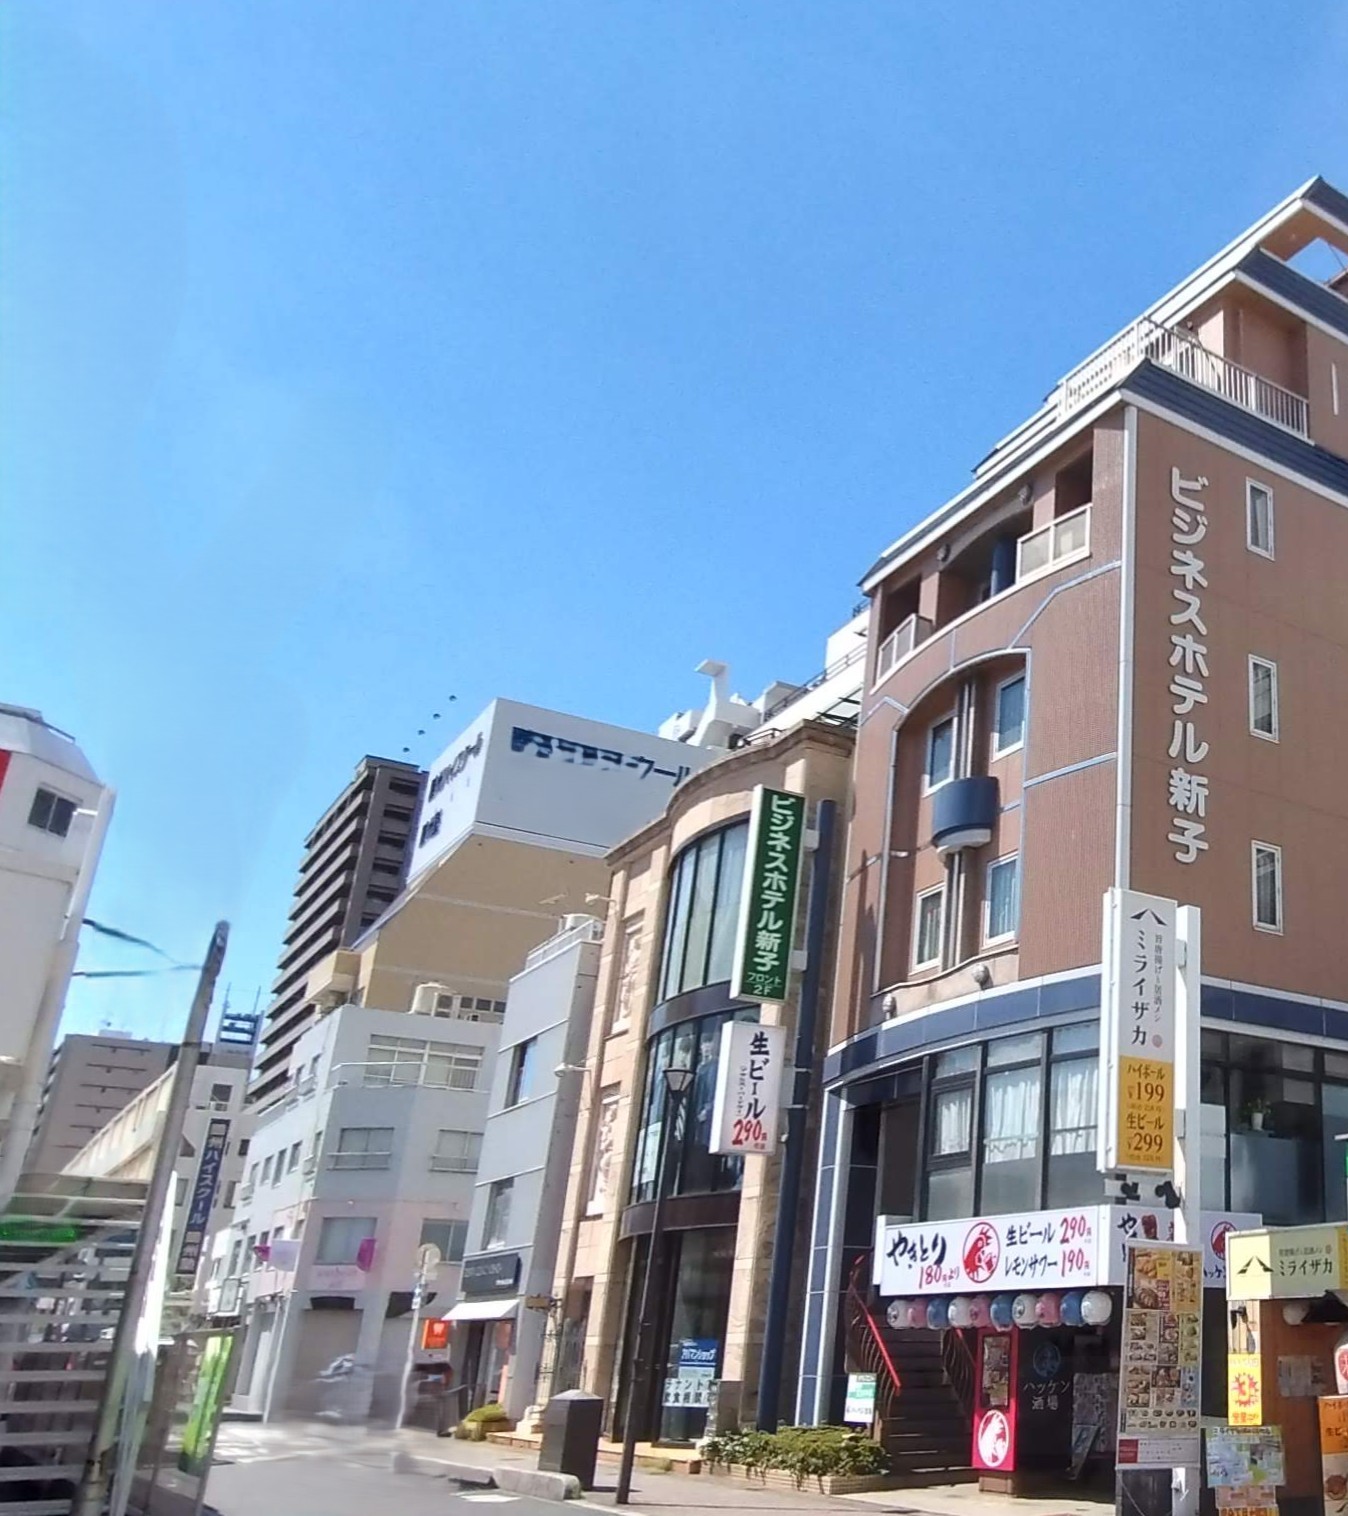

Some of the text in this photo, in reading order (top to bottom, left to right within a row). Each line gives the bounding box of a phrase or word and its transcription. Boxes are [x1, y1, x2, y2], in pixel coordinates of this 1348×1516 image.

[1168, 466, 1209, 864] ビジネスホテル新子
[751, 794, 795, 972] ビジネスホテル新子
[745, 971, 782, 988] フロント
[753, 984, 773, 996] 2F
[1131, 930, 1150, 1045] ミライザカ
[744, 1031, 770, 1119] 生ビール
[1128, 1064, 1165, 1080] ハイボール
[1126, 1112, 1165, 1130] 生ビール
[1006, 1222, 1056, 1247] 生ビール
[887, 1230, 947, 1269] やきとり
[1005, 1254, 1057, 1278] レモンサワー
[1280, 1258, 1333, 1276] ミライザカ
[1023, 1380, 1070, 1394] ハッケン
